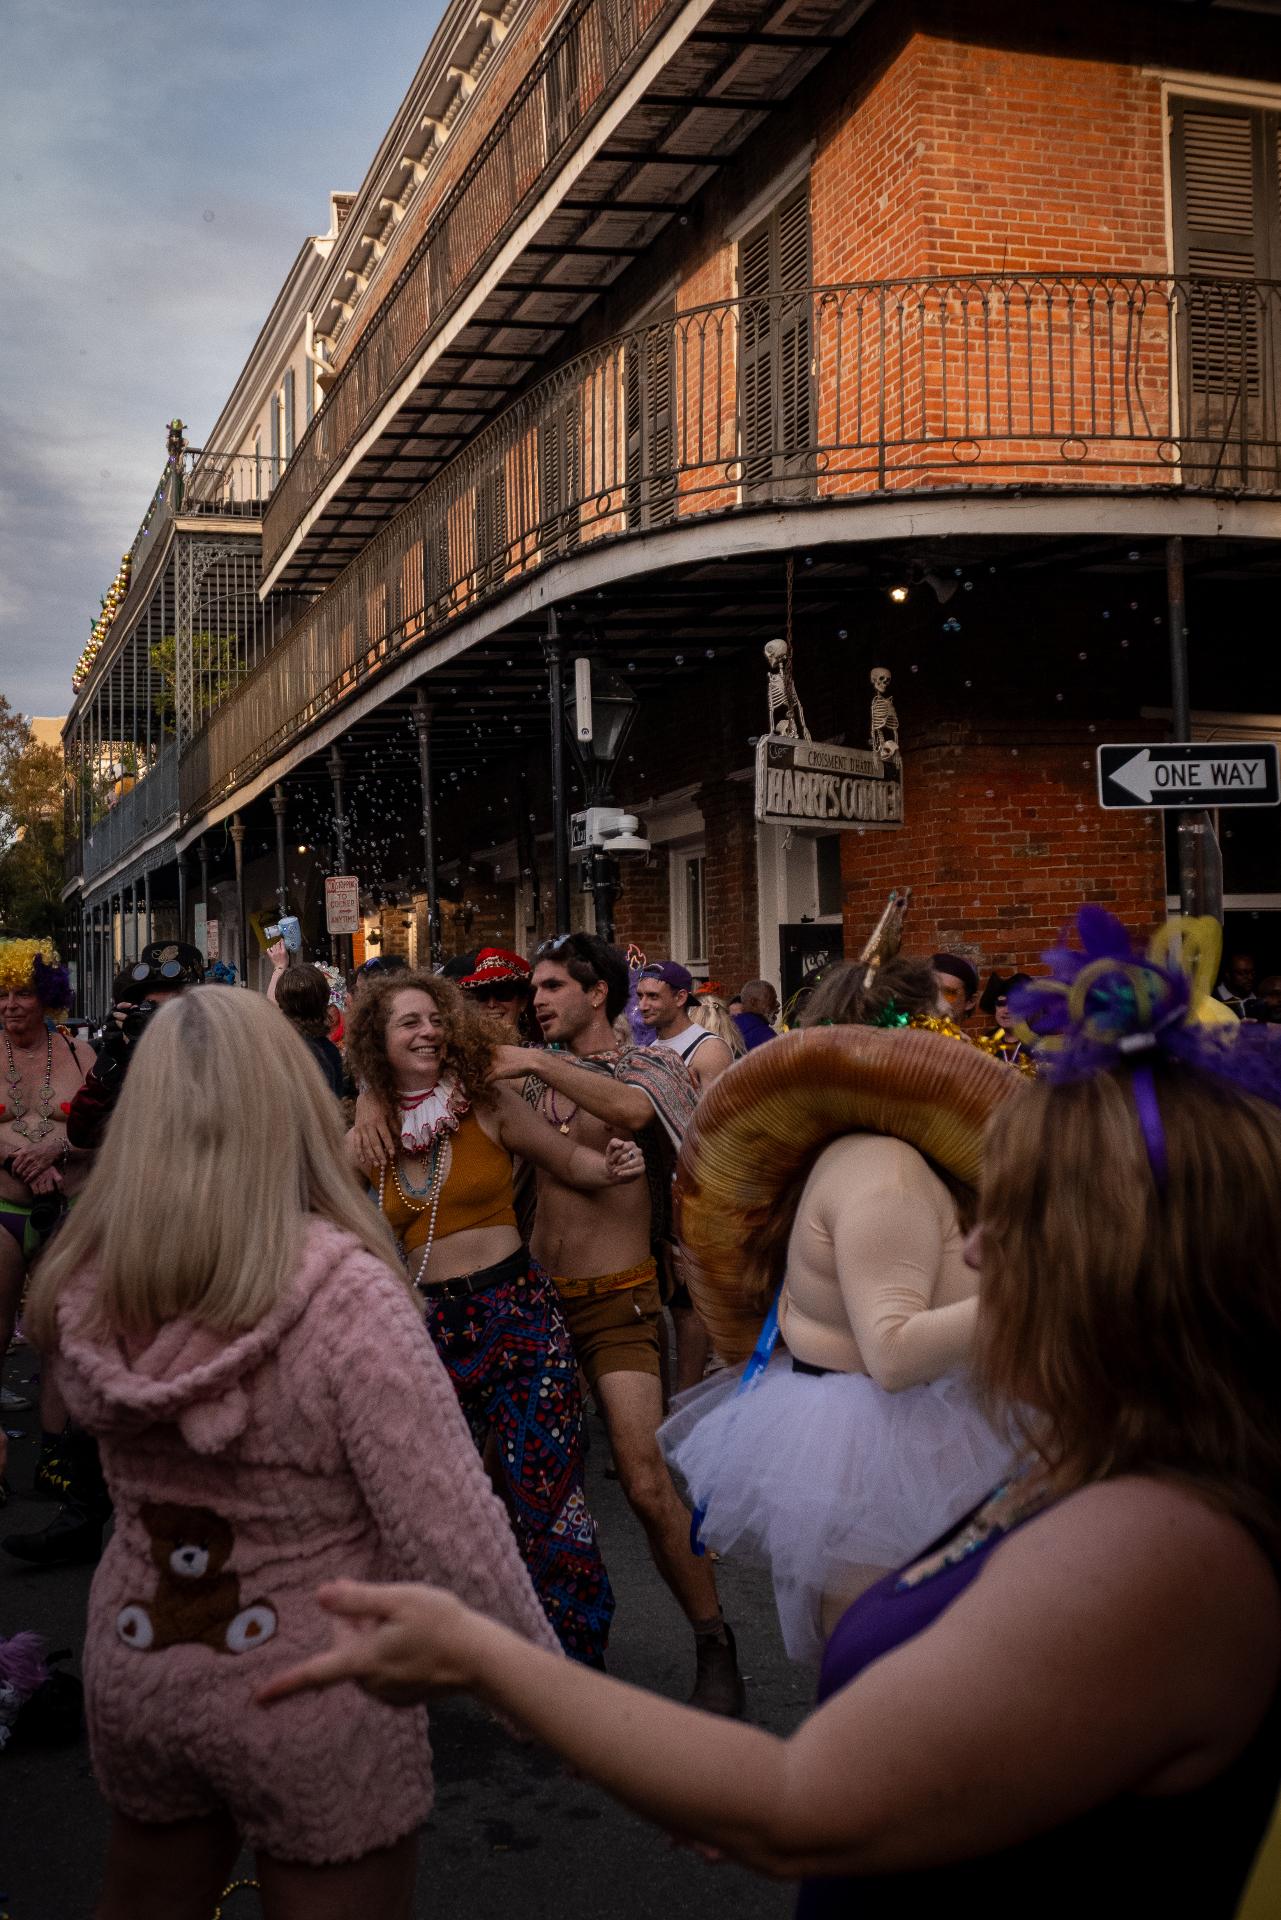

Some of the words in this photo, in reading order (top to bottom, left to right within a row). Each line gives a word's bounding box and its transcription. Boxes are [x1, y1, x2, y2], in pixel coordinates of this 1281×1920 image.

[1155, 764, 1201, 786] ONE
[1211, 762, 1258, 785] WAY
[840, 777, 901, 821] CORNER
